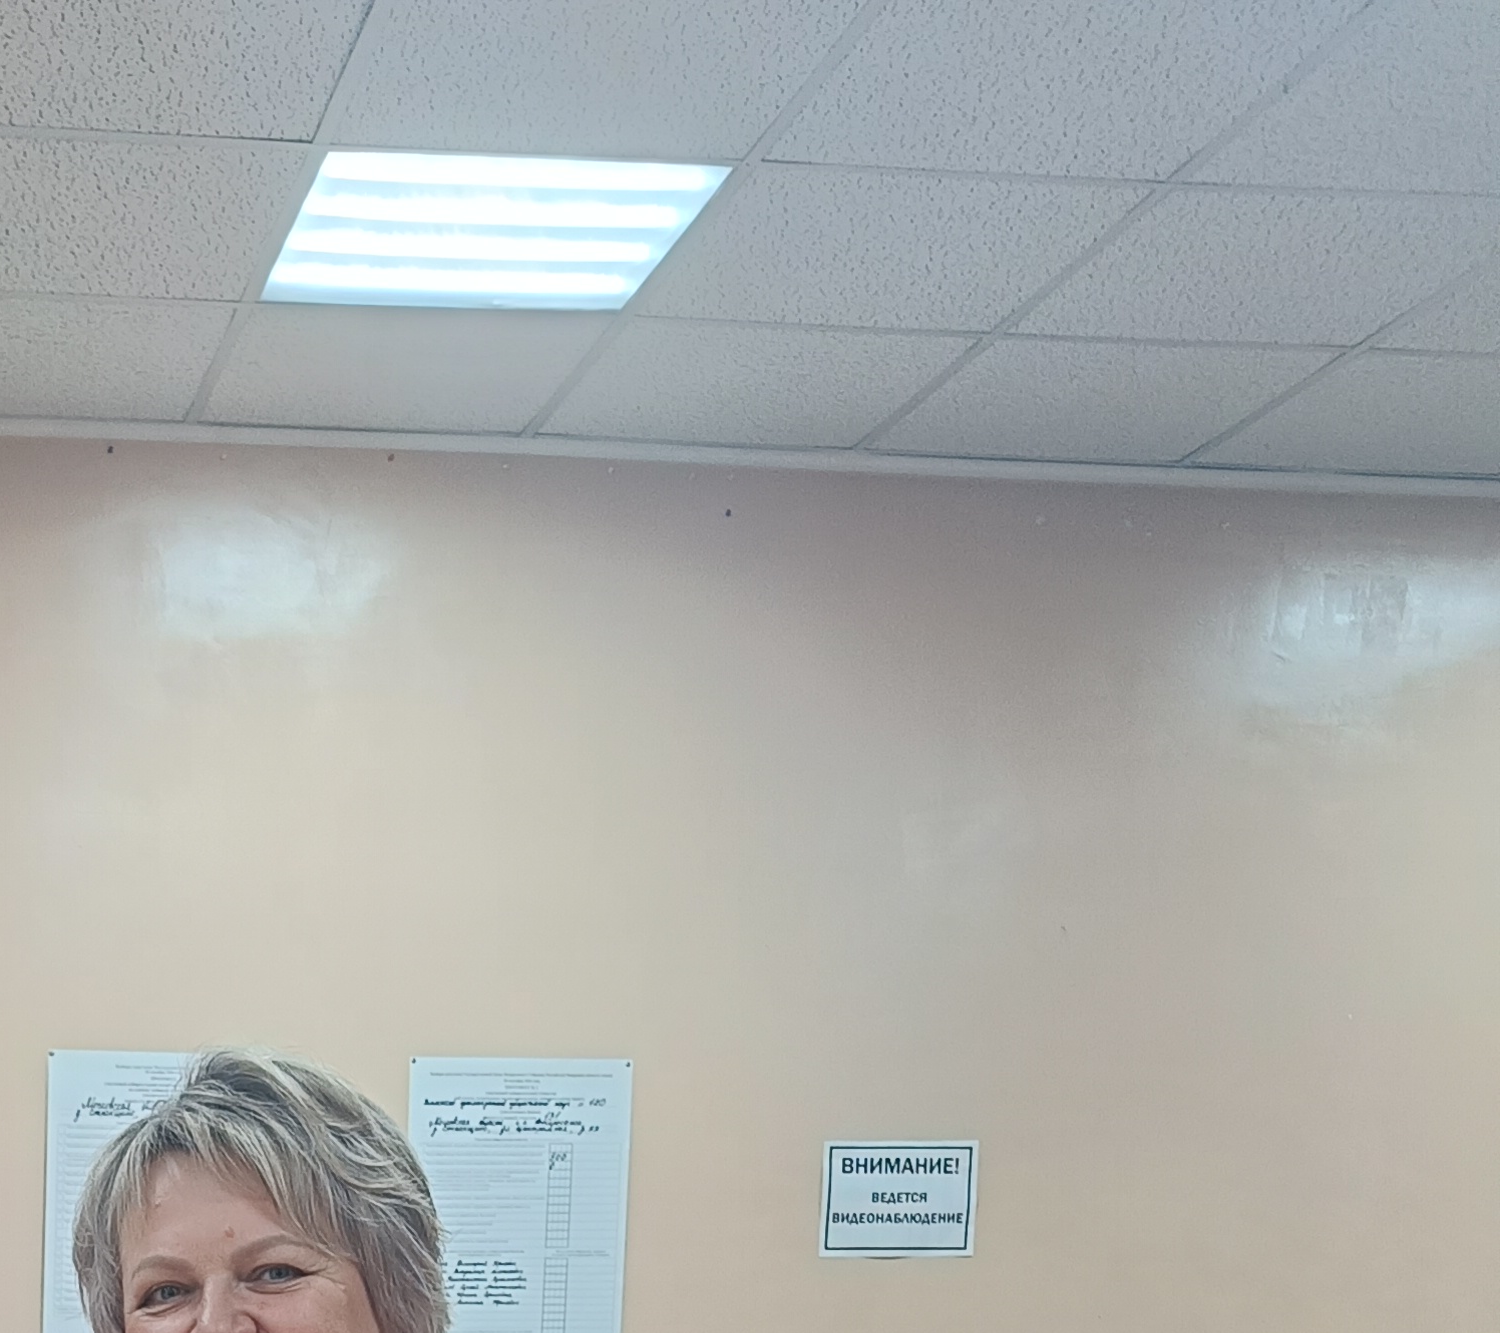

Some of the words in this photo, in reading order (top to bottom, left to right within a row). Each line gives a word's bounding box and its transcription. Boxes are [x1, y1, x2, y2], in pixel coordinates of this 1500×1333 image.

[841, 1157, 960, 1175] ВНИМАНИЕ!
[871, 1192, 928, 1204] ВЕДЕТСЯ
[832, 1212, 964, 1225] ВИДЕОНАБЛЮДЕНИЕ
